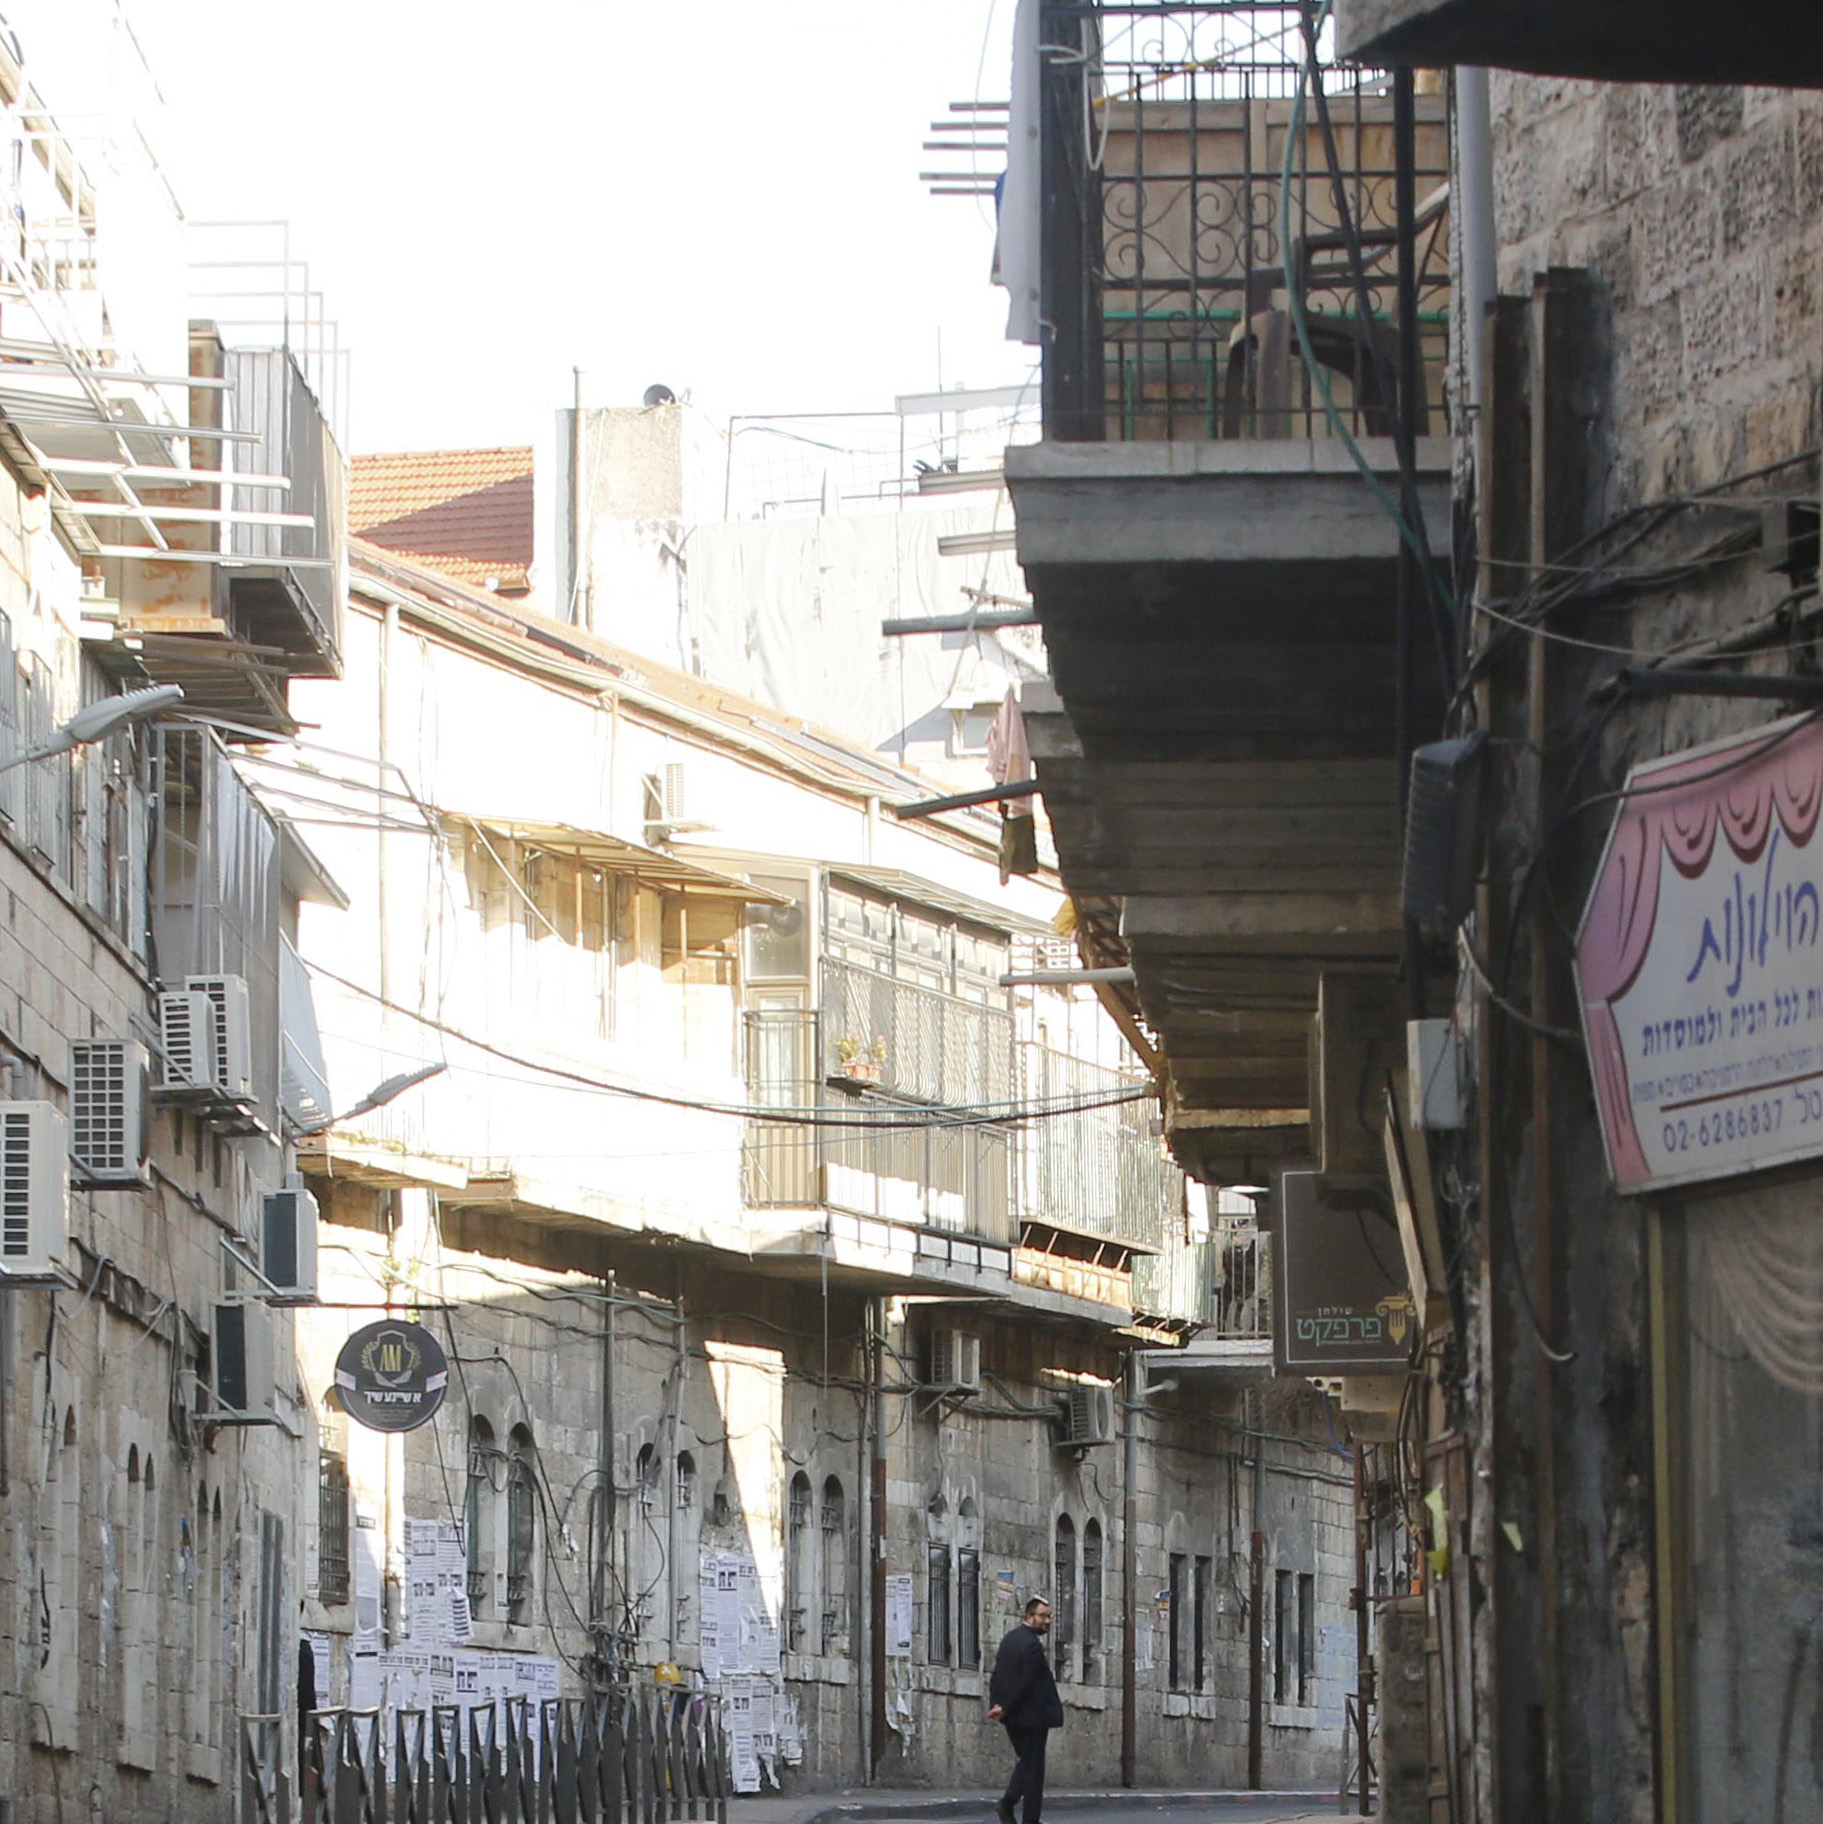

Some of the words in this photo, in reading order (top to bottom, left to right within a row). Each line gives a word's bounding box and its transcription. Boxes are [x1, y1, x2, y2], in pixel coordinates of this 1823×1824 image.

[1686, 827, 1820, 998] הוילונות
[1731, 1001, 1767, 1037] הבית
[1775, 986, 1799, 1027] לכל
[1642, 1005, 1722, 1057] ולמוסדות
[1663, 1098, 1783, 1153] 02-6286837
[1297, 1318, 1381, 1347] פרפקט
[1317, 1306, 1354, 1318] שולחן
